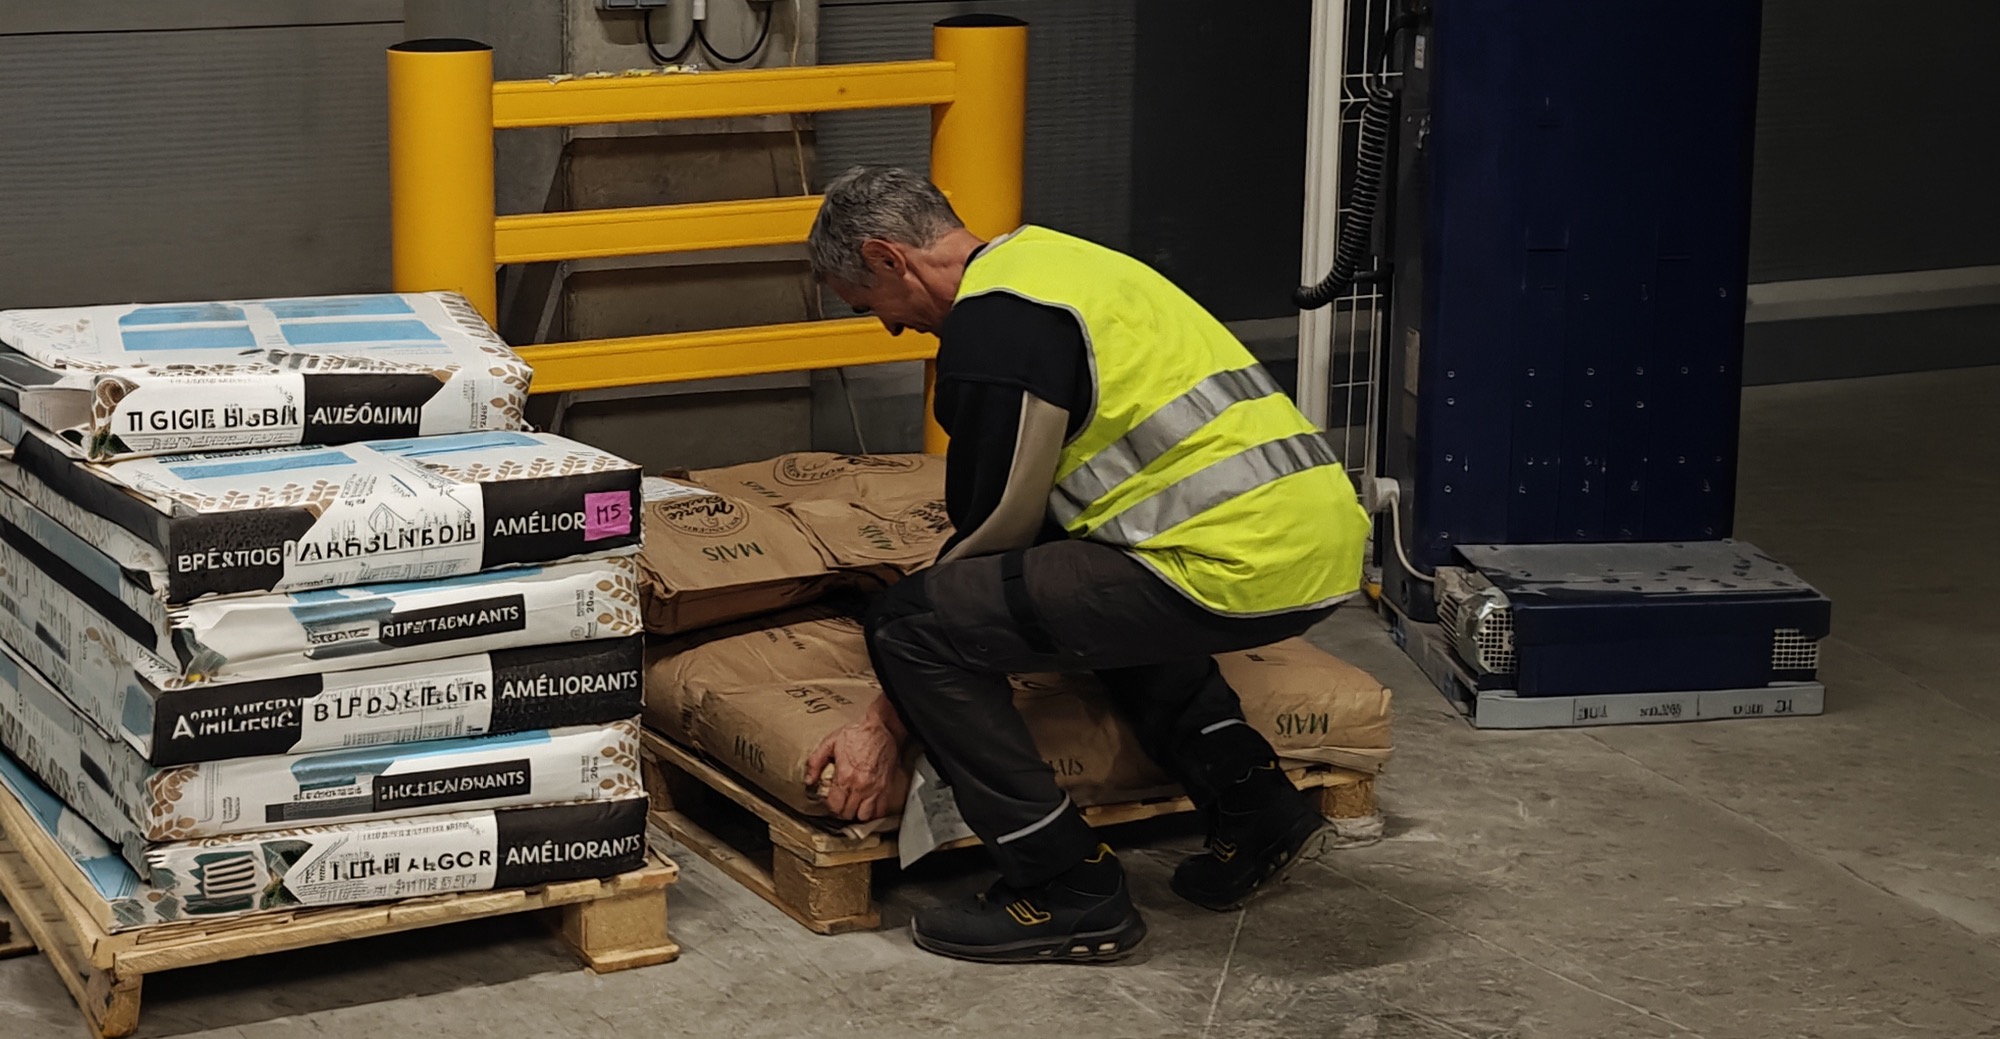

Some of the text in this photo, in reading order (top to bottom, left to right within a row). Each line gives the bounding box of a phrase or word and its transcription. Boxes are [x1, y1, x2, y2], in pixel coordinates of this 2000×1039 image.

[597, 503, 622, 526] M5
[667, 501, 735, 521] Marie
[501, 670, 639, 700] AMÉLIORANTS
[1275, 712, 1329, 739] MAÏS
[505, 832, 641, 867] AMÉLIORANTS
